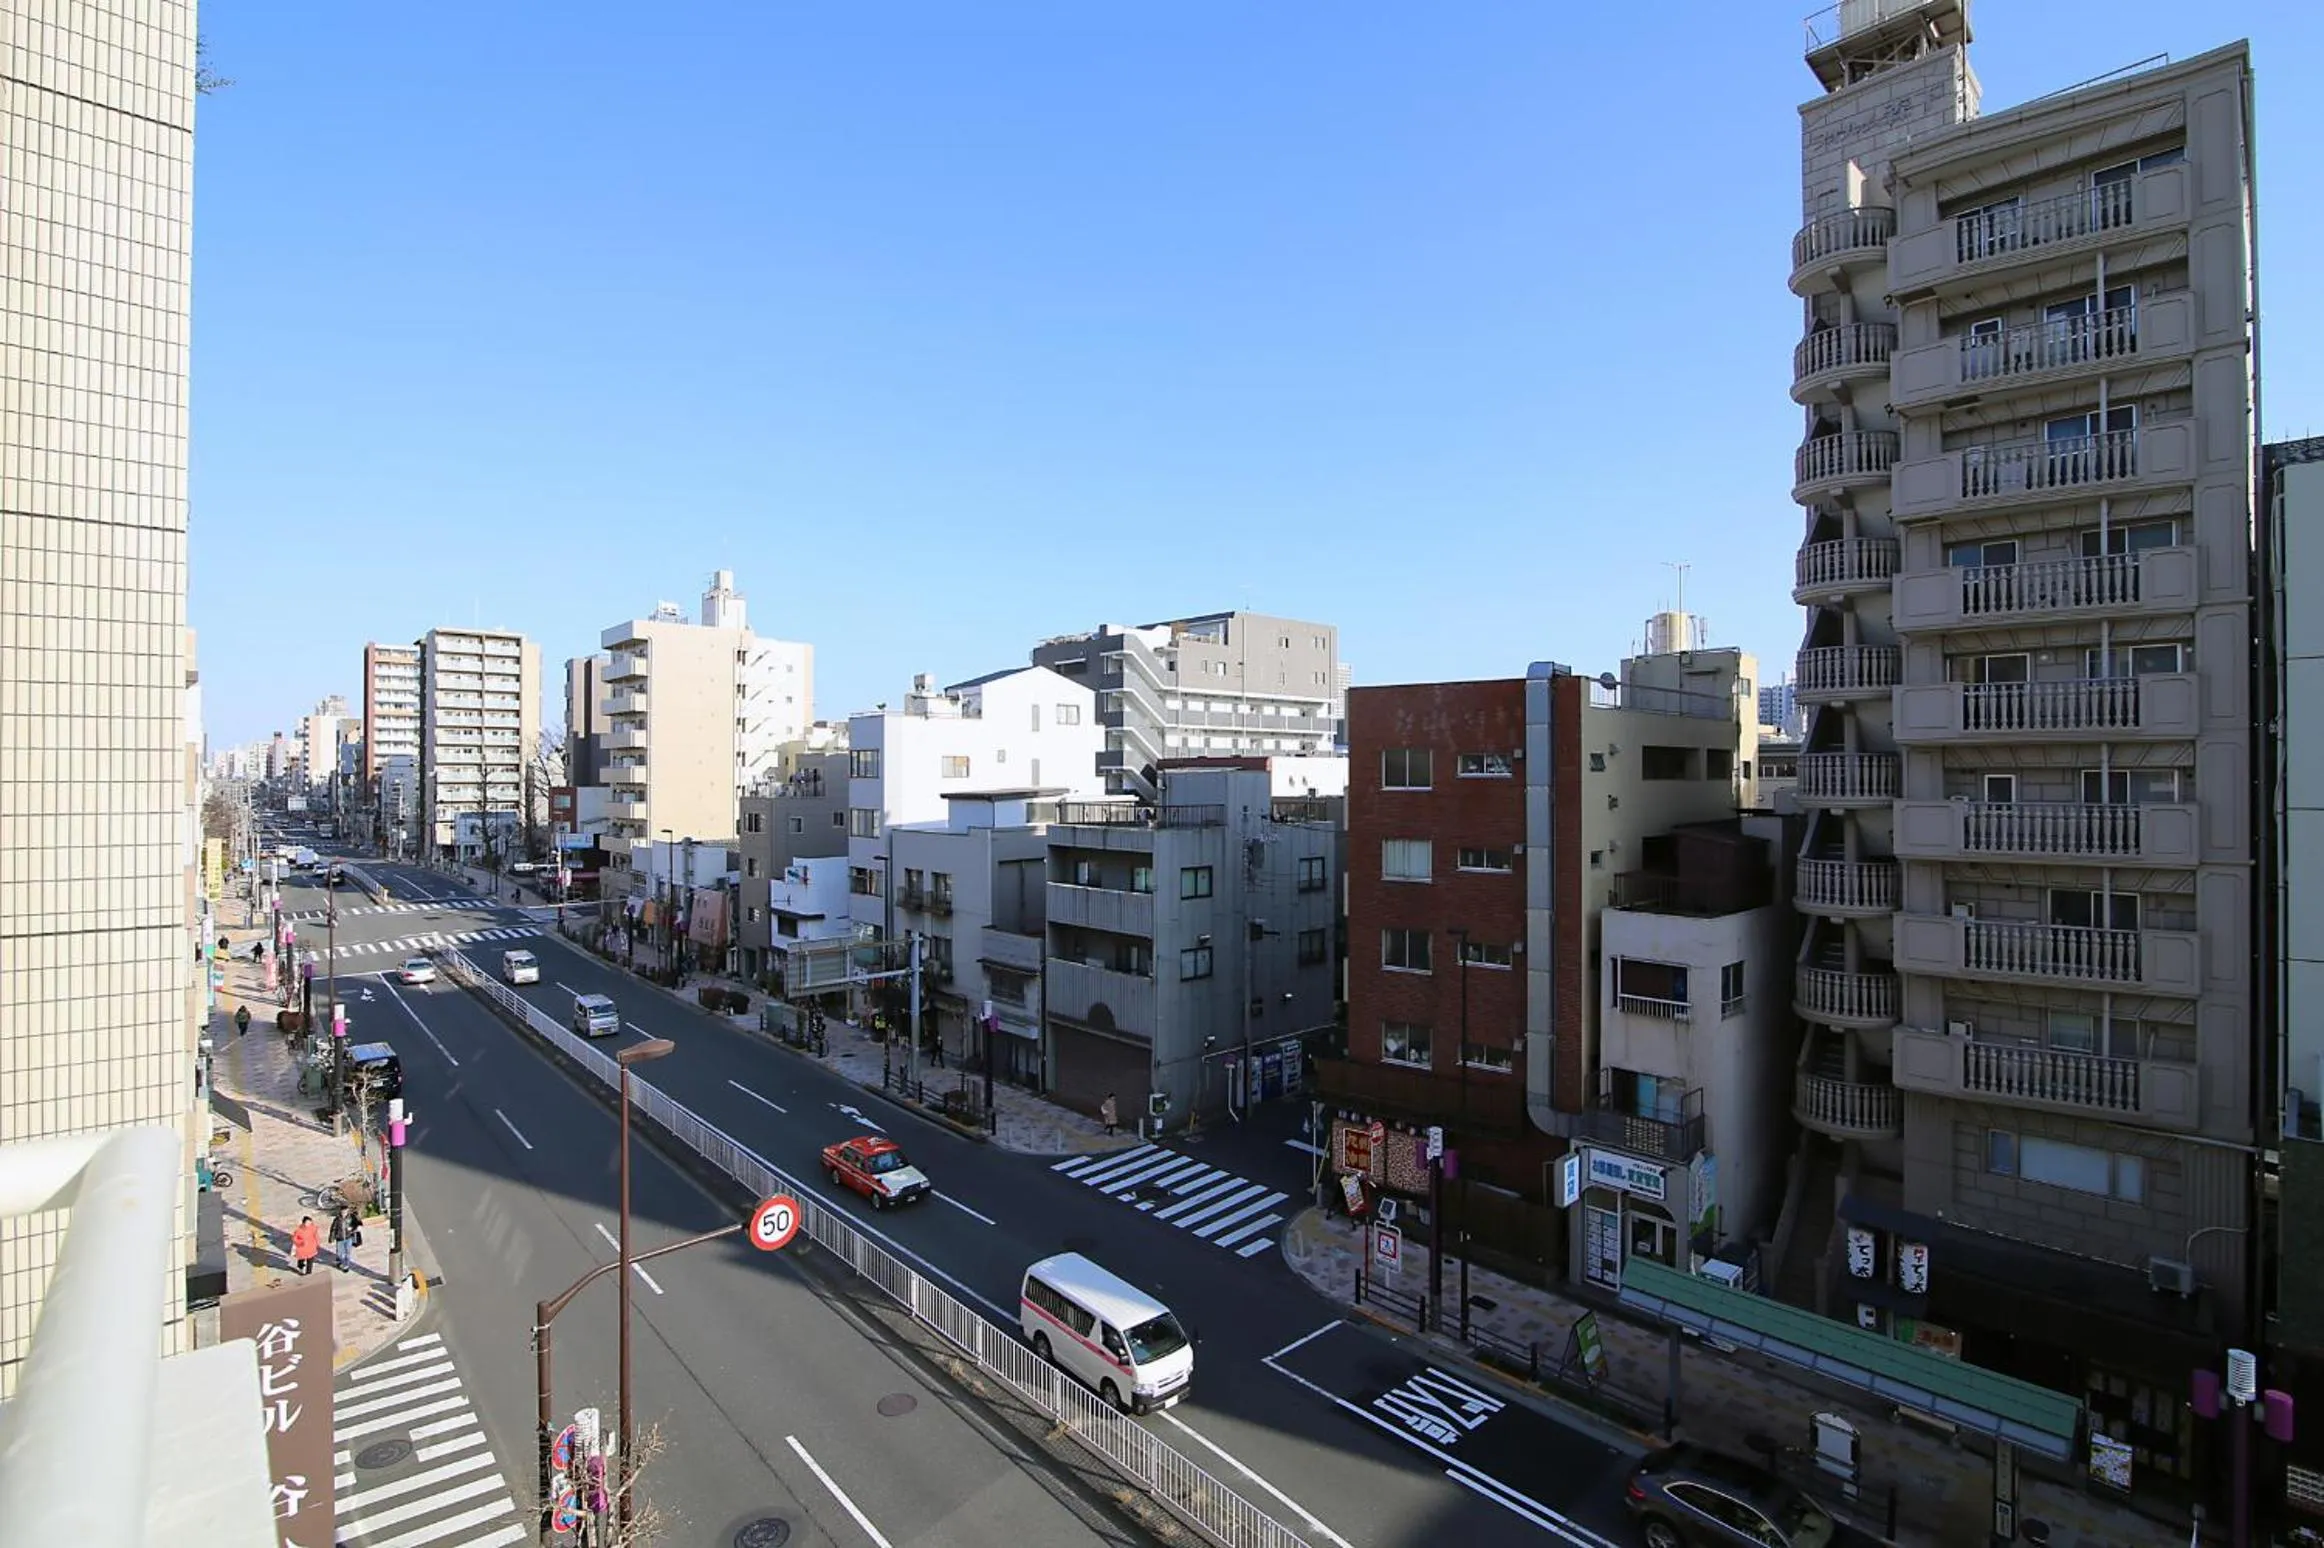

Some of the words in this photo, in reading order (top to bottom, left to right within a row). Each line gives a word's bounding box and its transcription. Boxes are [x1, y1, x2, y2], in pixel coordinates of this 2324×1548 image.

[763, 1209, 789, 1236] 50
[256, 1319, 303, 1433] 谷ビル
[1373, 1367, 1506, 1444] バス停
